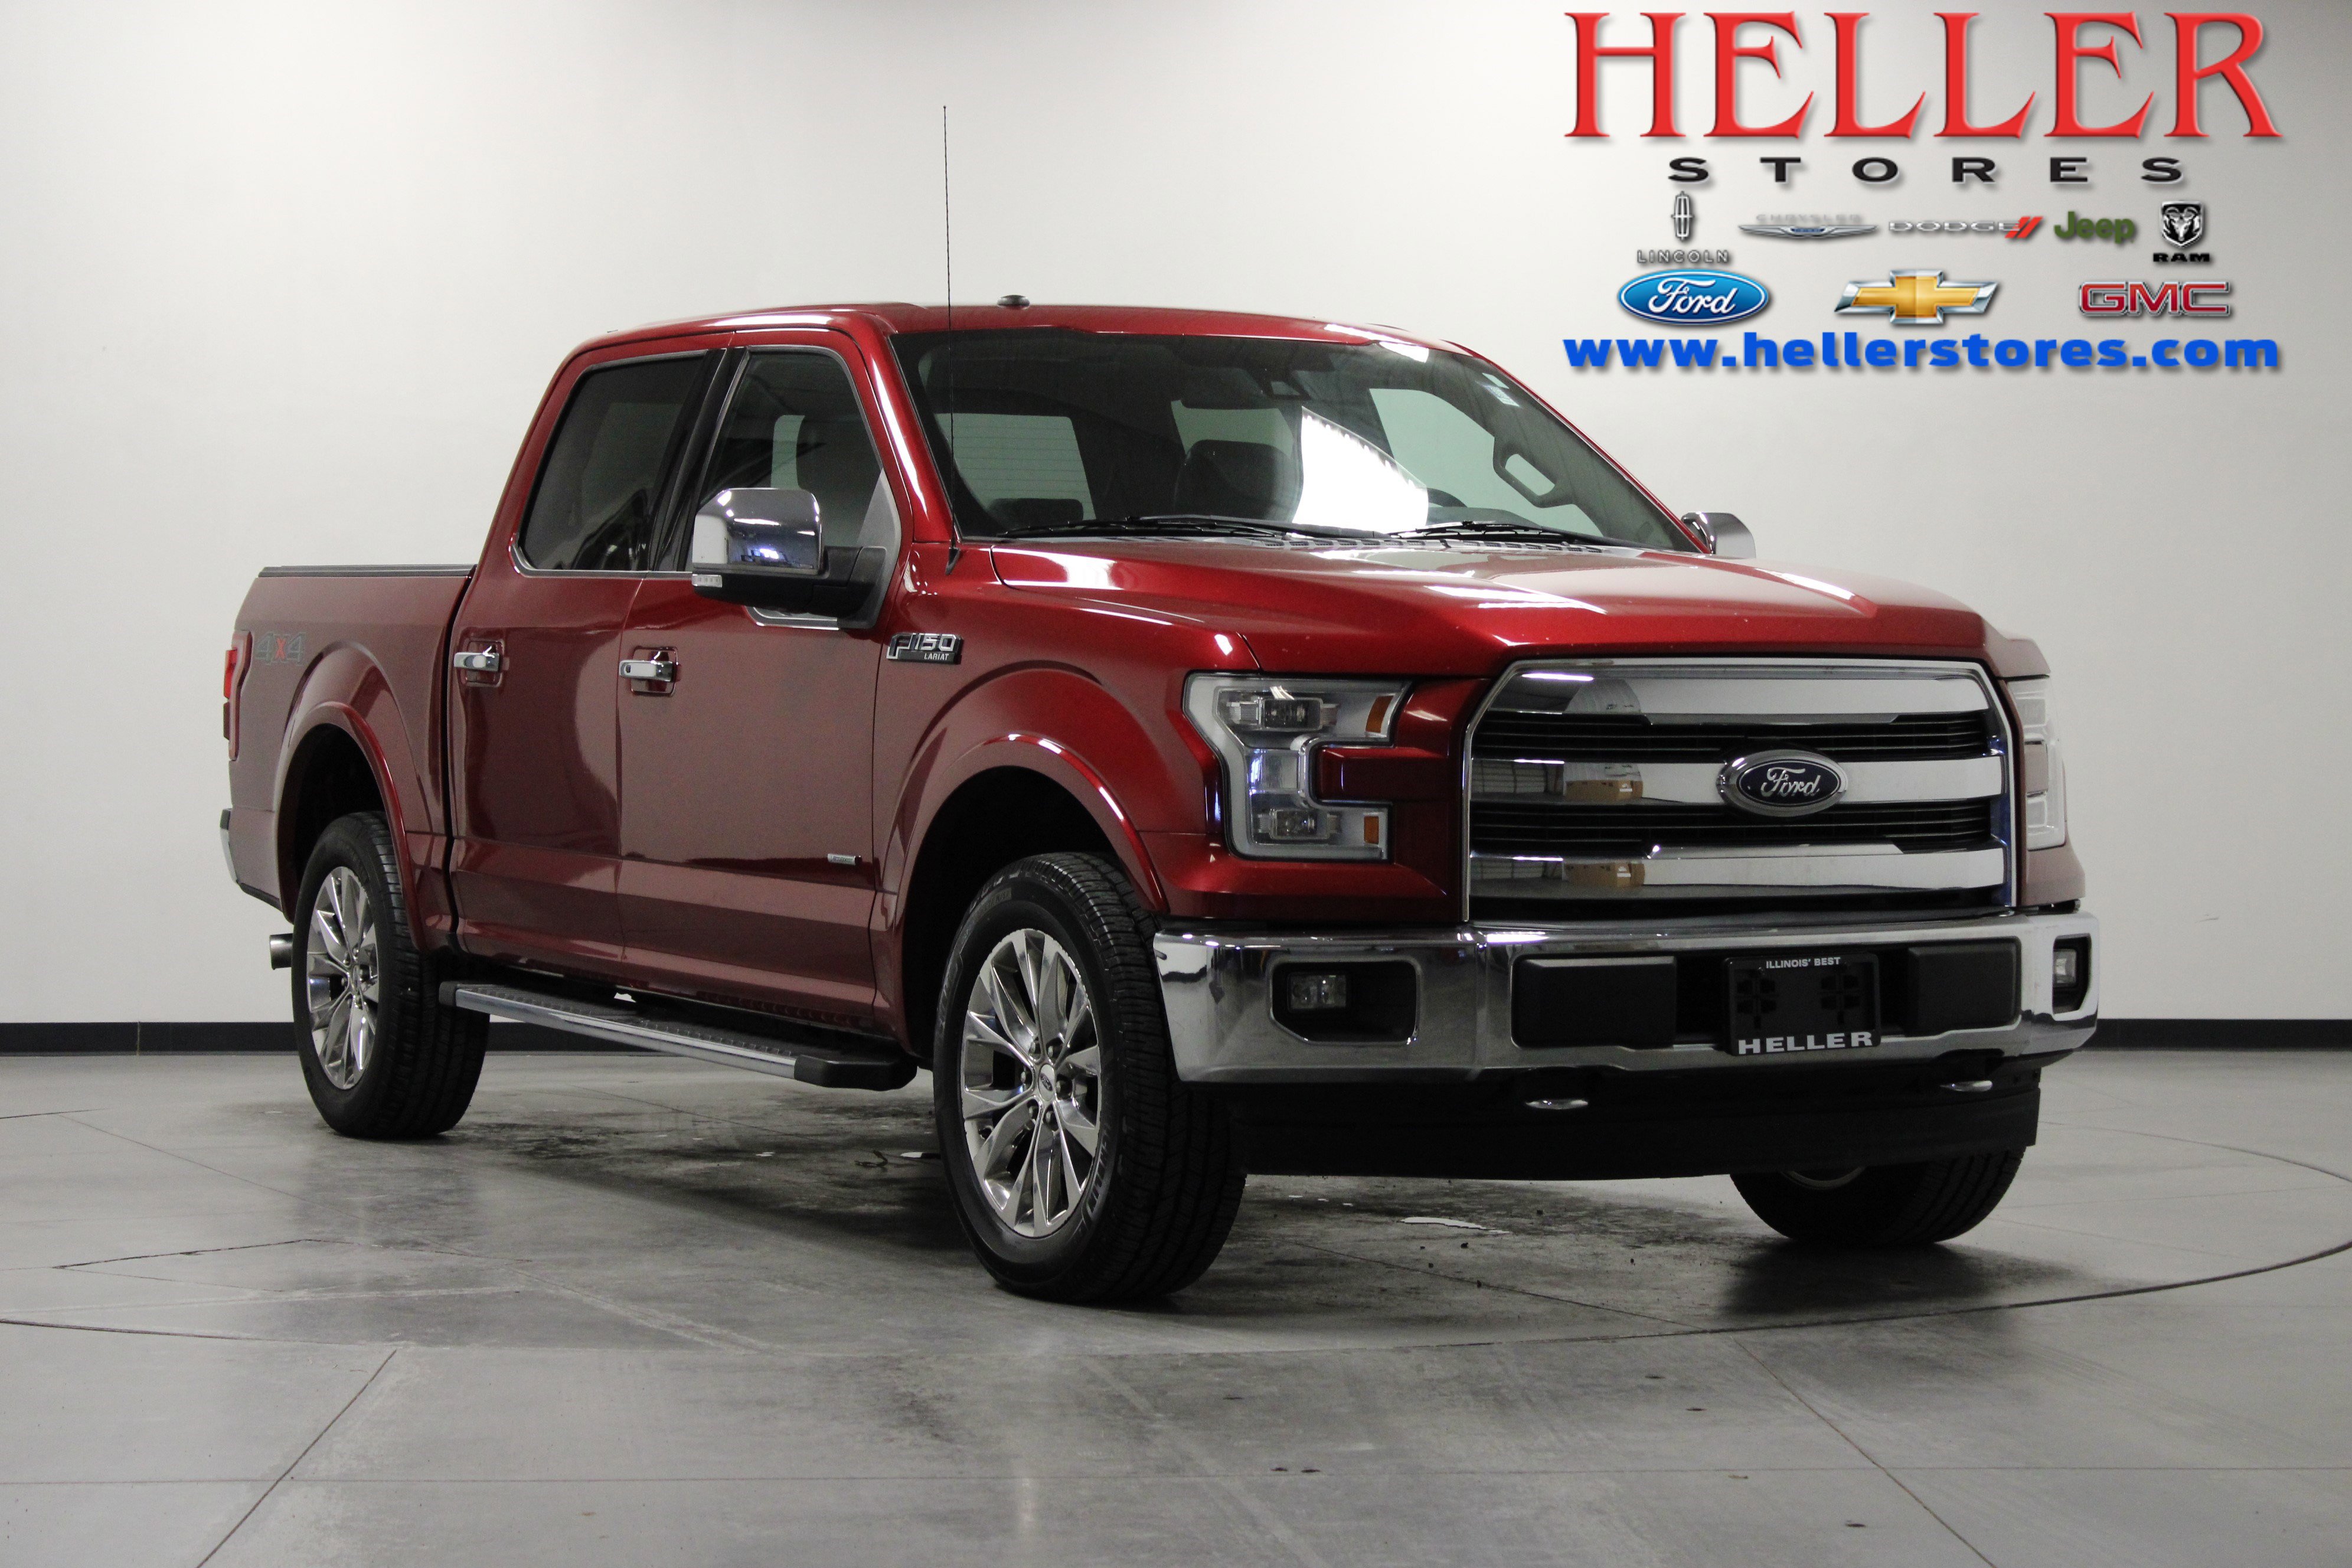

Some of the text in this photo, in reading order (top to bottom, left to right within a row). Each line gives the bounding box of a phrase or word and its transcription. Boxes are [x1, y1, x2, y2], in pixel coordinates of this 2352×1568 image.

[924, 652, 949, 661] LARIAT
[1760, 766, 1821, 797] Ford
[1814, 956, 1841, 966] BEST
[1738, 1031, 1873, 1054] HELLER
